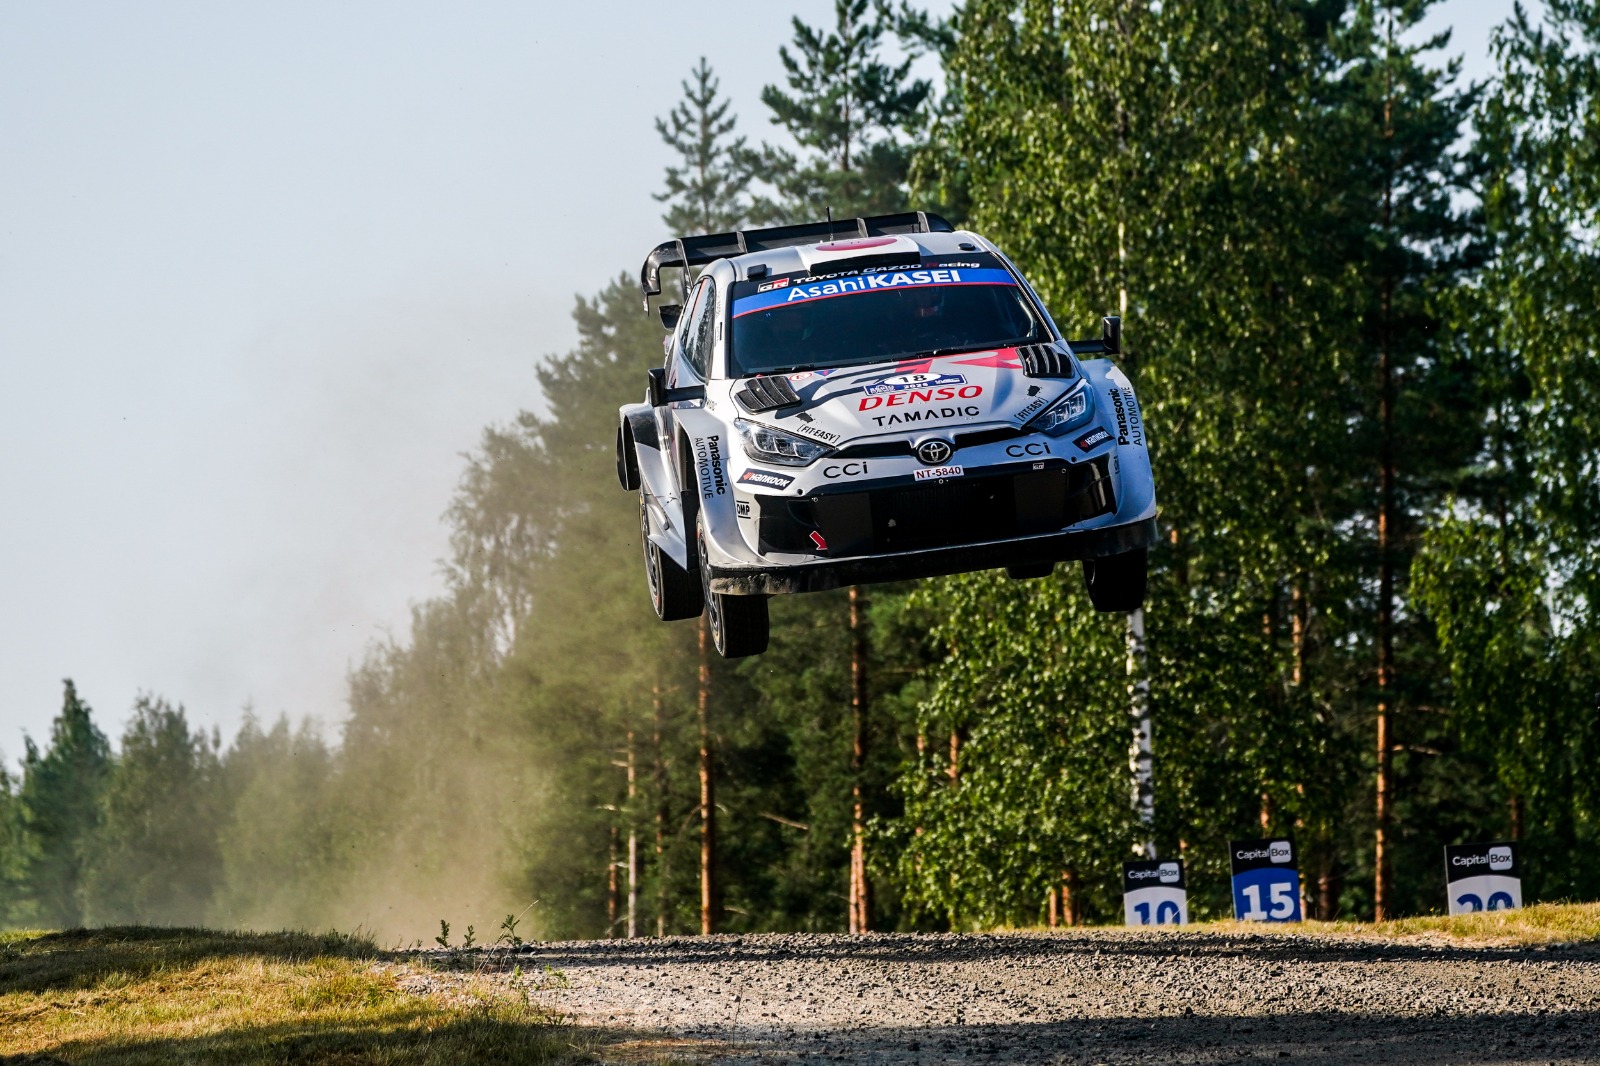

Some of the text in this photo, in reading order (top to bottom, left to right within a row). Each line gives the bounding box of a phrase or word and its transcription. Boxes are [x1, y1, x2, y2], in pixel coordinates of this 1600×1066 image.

[758, 261, 981, 293] GR TOYOTA GAZOO Racing
[900, 374, 927, 383] 18
[858, 384, 983, 412] DENSO
[872, 405, 980, 427] TAMADIC
[1108, 388, 1130, 446] Panasonic
[1121, 386, 1143, 447] AUTOMOTIVE
[694, 437, 714, 500] AUTOMOTIVE
[707, 435, 726, 495] Panasonic
[916, 466, 962, 479] NT-5840
[736, 503, 750, 516] OMP
[1134, 900, 1181, 926] 10
[1242, 882, 1295, 921] 15
